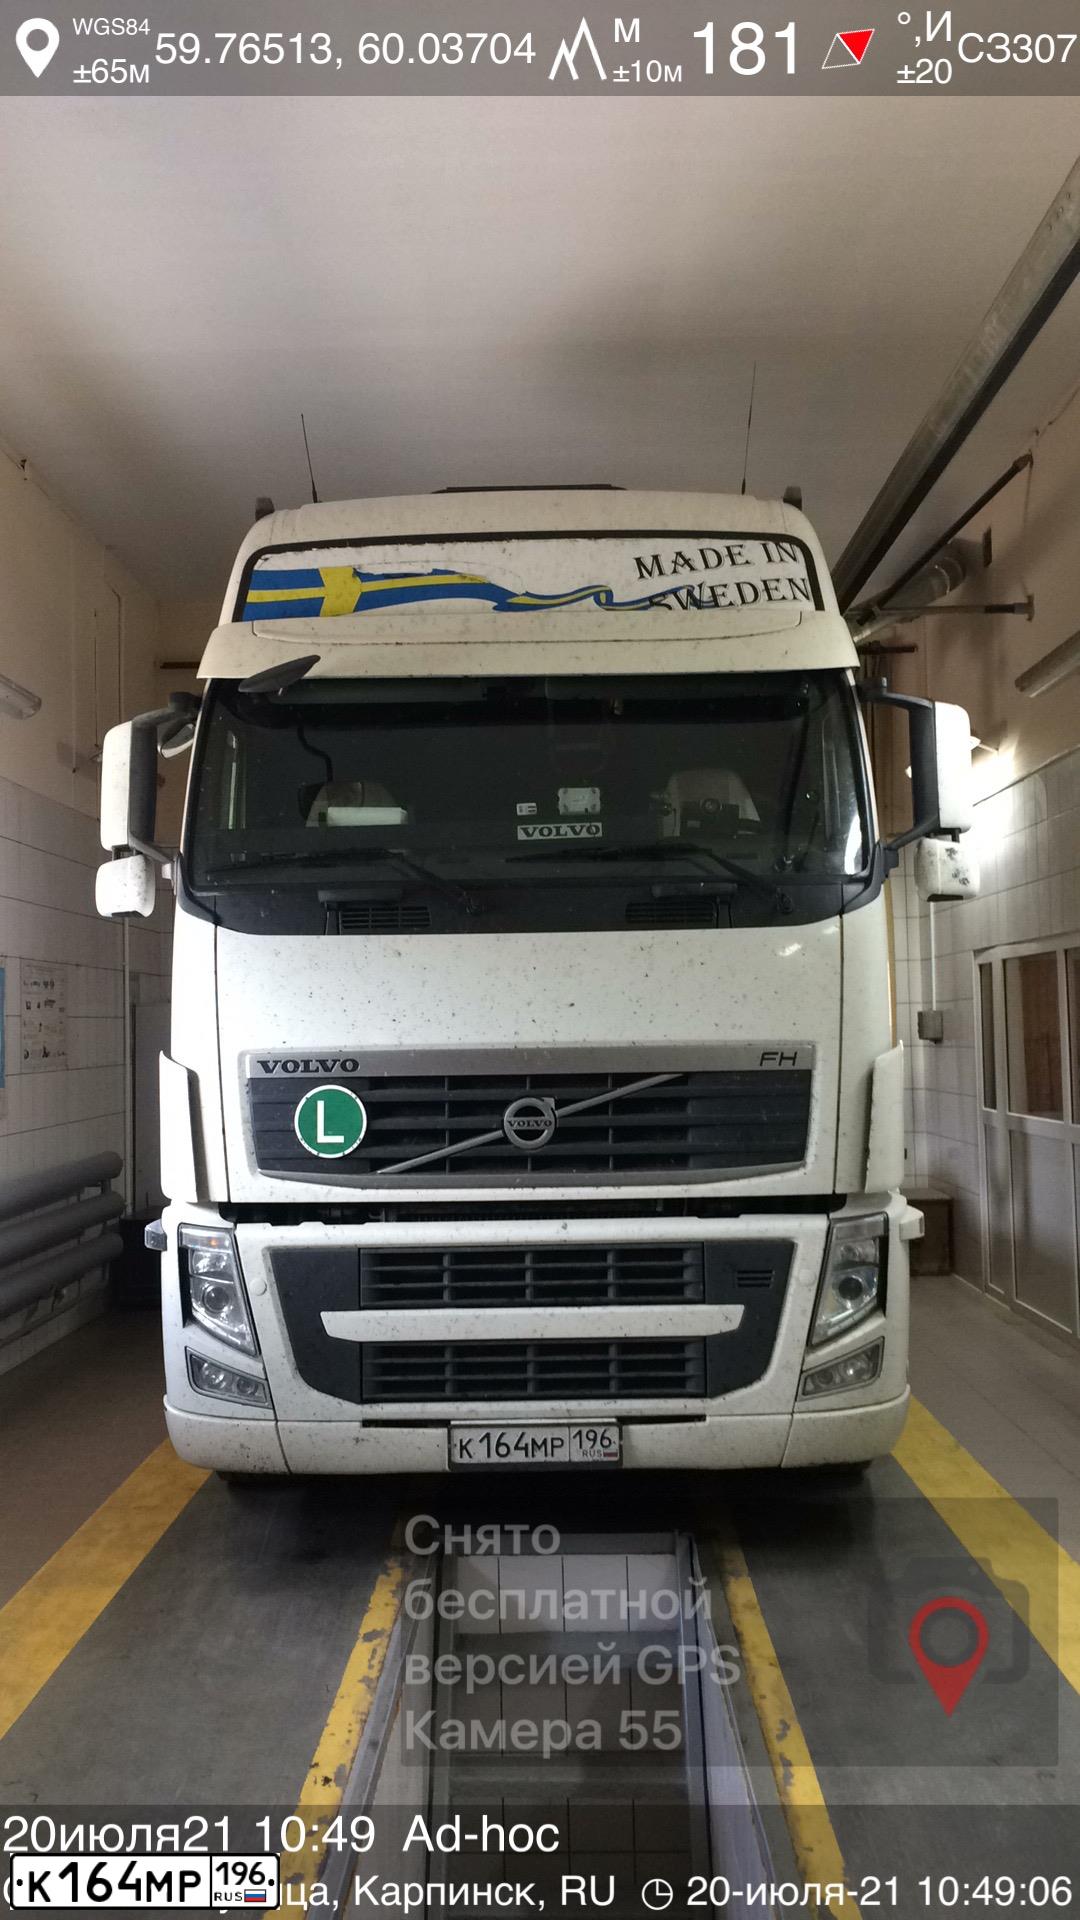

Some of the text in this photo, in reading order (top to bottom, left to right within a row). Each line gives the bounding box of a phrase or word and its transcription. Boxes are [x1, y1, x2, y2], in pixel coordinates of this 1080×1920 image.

[634, 542, 800, 580] MADE IN
[520, 824, 601, 838] VOLVO
[257, 1058, 360, 1074] VOLVO
[760, 1051, 798, 1067] FH
[317, 1100, 345, 1144] L
[507, 1119, 553, 1128] VOLVO
[572, 1428, 612, 1450] 196
[582, 1450, 603, 1458] RUS
